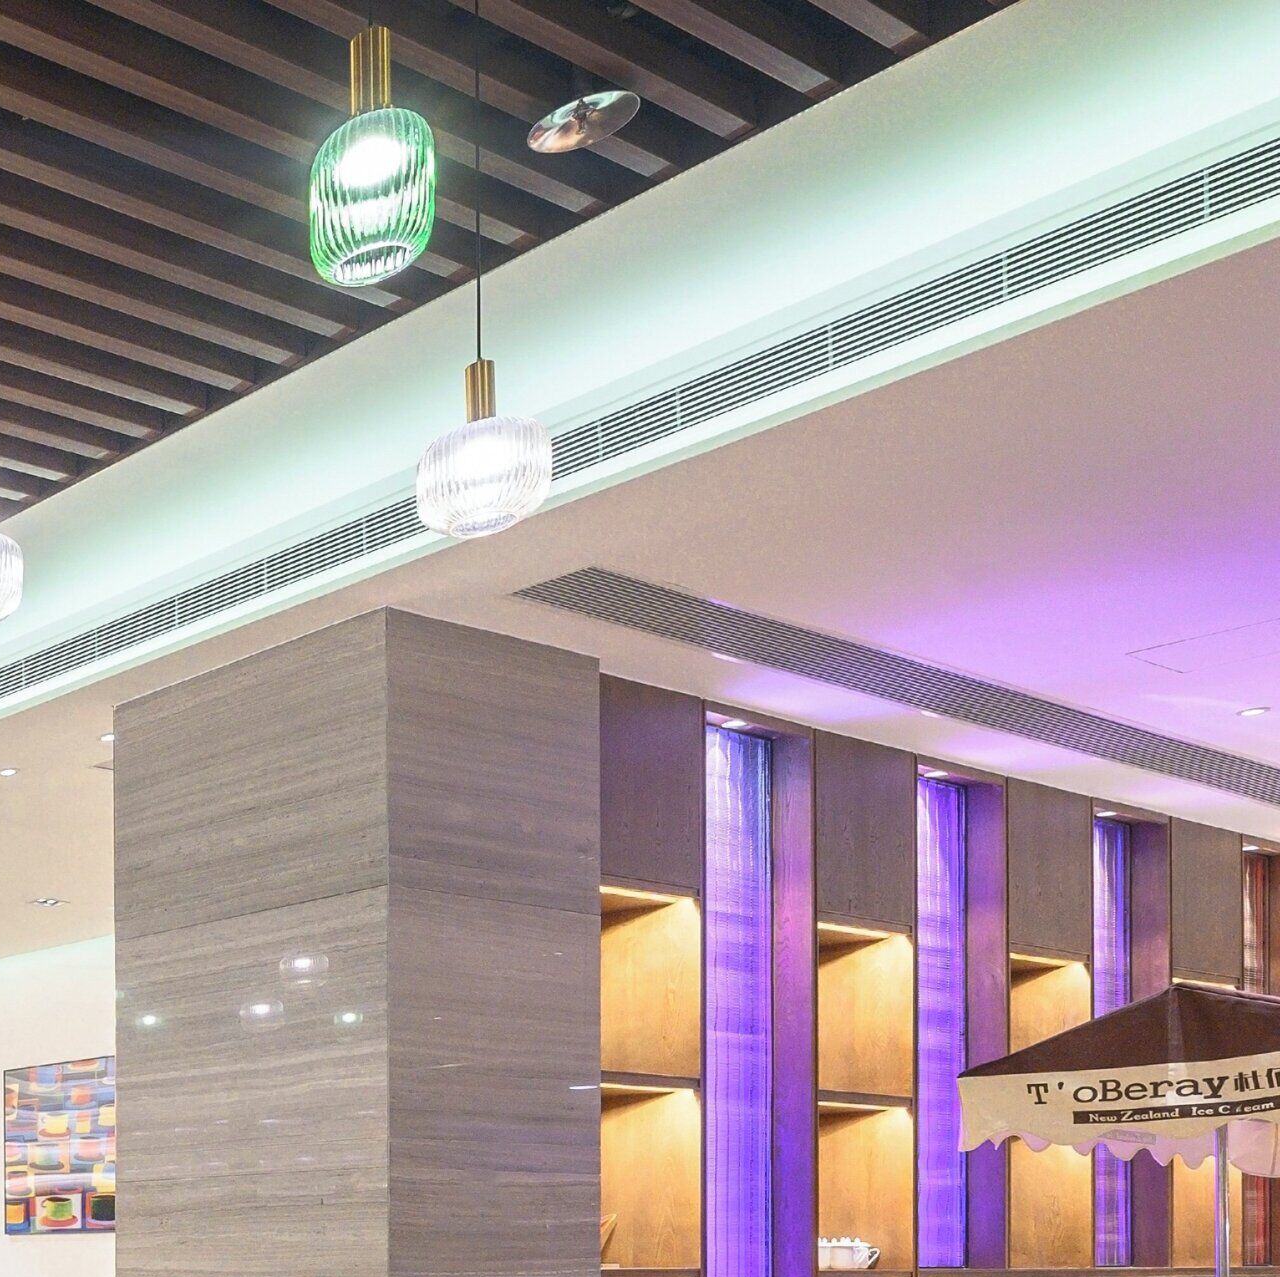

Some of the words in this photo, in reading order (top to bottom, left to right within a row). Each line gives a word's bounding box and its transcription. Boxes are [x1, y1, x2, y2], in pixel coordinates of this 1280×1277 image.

[1088, 1113, 1118, 1122] New
[1120, 1108, 1180, 1121] Zealand
[1191, 1104, 1214, 1116] Ice
